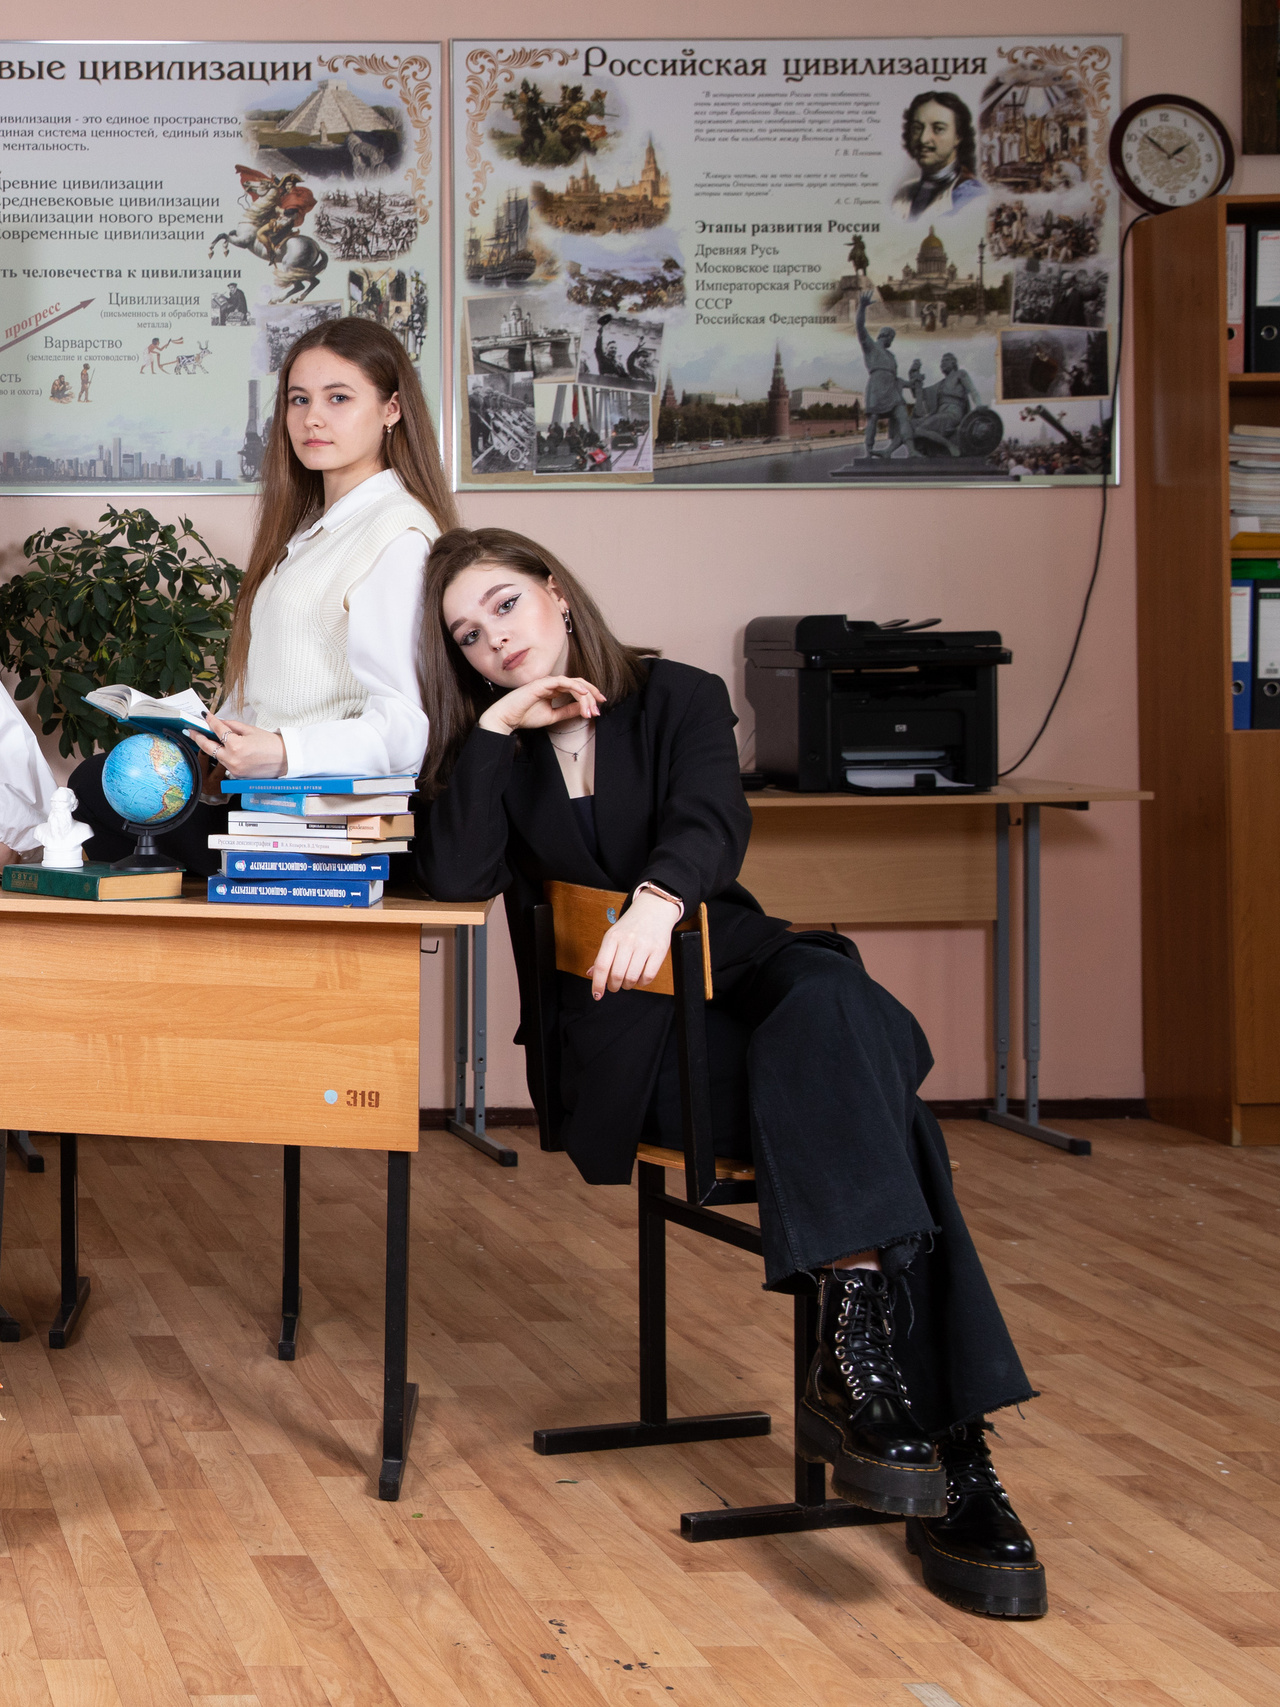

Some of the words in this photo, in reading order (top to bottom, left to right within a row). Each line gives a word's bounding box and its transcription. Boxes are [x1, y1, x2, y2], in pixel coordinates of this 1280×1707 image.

[582, 46, 767, 77] Российская
[784, 53, 987, 83] цивилизация
[79, 59, 312, 86] цивилизации
[82, 115, 102, 124] это
[106, 115, 150, 126] единое
[153, 115, 242, 126] пространство,
[1159, 112, 1170, 122] 12
[1183, 118, 1188, 128] 1
[38, 128, 87, 138] система
[91, 127, 158, 140] ценностей,
[162, 127, 209, 139] единый
[213, 128, 243, 138] язык
[1197, 133, 1205, 142] 2
[3, 142, 90, 151] ментальность.
[63, 180, 163, 192] цивилизации
[119, 197, 220, 208] цивилизации
[99, 214, 153, 224] нового
[159, 214, 223, 226] времени
[695, 220, 746, 233] Этапы
[751, 222, 823, 237] развития
[827, 220, 881, 233] России
[104, 230, 205, 242] цивилизации
[694, 244, 747, 258] Древняя
[751, 244, 780, 258] Русь
[22, 268, 123, 279] человечества
[127, 268, 137, 279] к
[141, 268, 242, 280] цивилизации
[695, 262, 769, 273] Московское
[773, 264, 821, 276] царство
[695, 280, 790, 293] Императорская
[793, 280, 836, 291] Россия
[108, 292, 200, 306] Цивилизация
[695, 298, 733, 310] СССР
[4, 300, 62, 340] прогресс
[100, 310, 159, 318] (письменность
[168, 309, 208, 320] обработка
[695, 314, 765, 325] Российская
[769, 314, 837, 326] Федерация
[137, 321, 172, 329] металла)
[44, 336, 123, 351] Варварство
[26, 353, 75, 362] (земледелие
[84, 353, 140, 362] скотоводство)
[17, 388, 43, 397] охота)
[217, 839, 235, 847] Русская
[249, 861, 278, 870] ЛИТЕРАТУР
[278, 862, 307, 871] ОБЩНОСТЬ
[312, 862, 336, 871] НАРОДОВ
[337, 863, 366, 872] ОБЩНОСТЬ
[230, 885, 258, 896] ЛИТЕРАТУР
[258, 886, 288, 897] ОБЩНОСТЬ
[292, 887, 316, 897] НАРОДОВ
[317, 888, 346, 898] ОБЩНОСТЬ
[346, 1089, 380, 1108] 319
